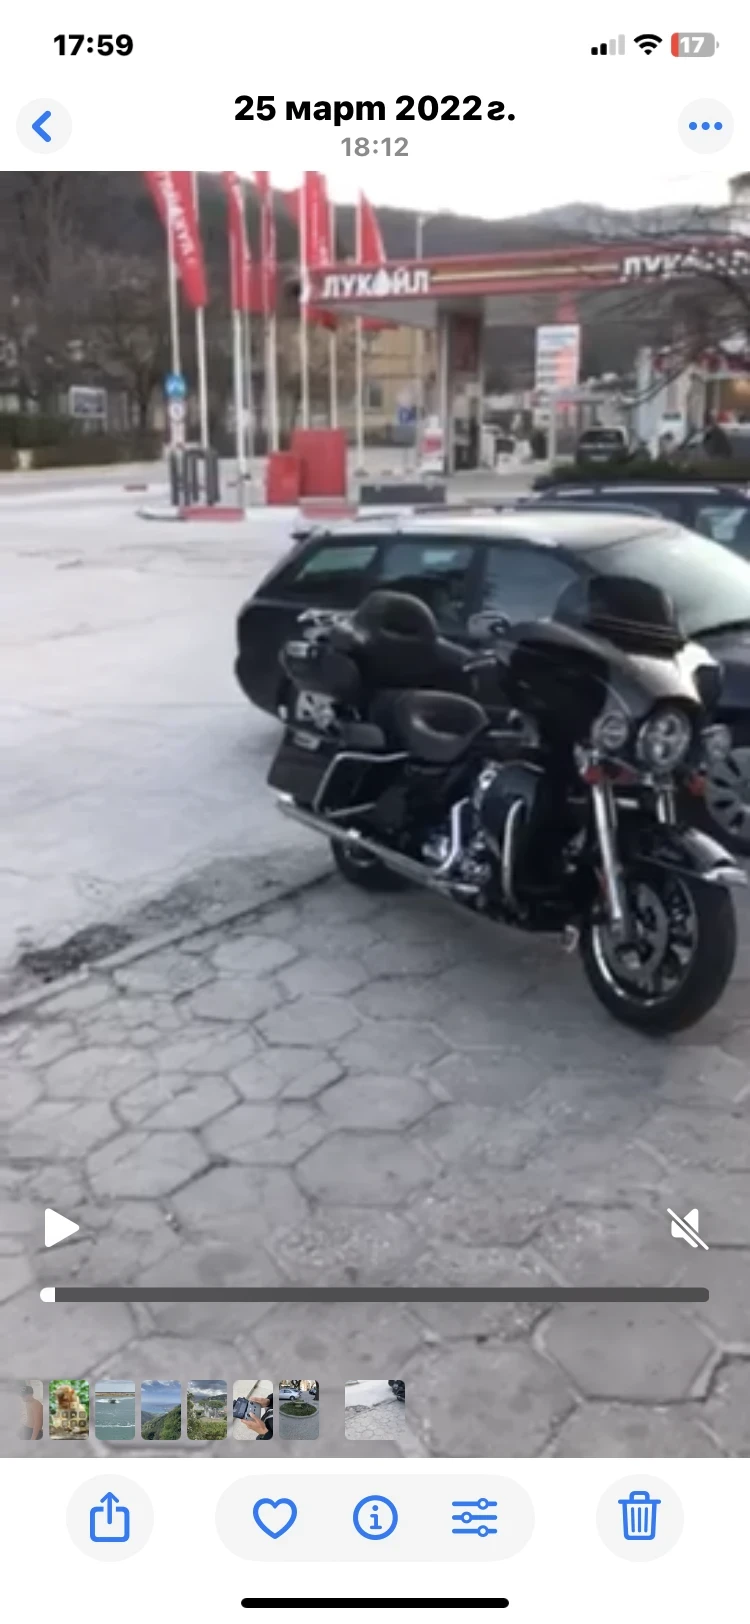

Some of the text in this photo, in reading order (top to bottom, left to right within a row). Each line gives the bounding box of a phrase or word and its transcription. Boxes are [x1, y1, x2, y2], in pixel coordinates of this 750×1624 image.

[54, 33, 133, 56] 17:59
[680, 36, 704, 53] 17
[235, 95, 276, 120] 25
[286, 100, 385, 126] март
[396, 95, 482, 120] 2022
[341, 137, 409, 157] 18:12
